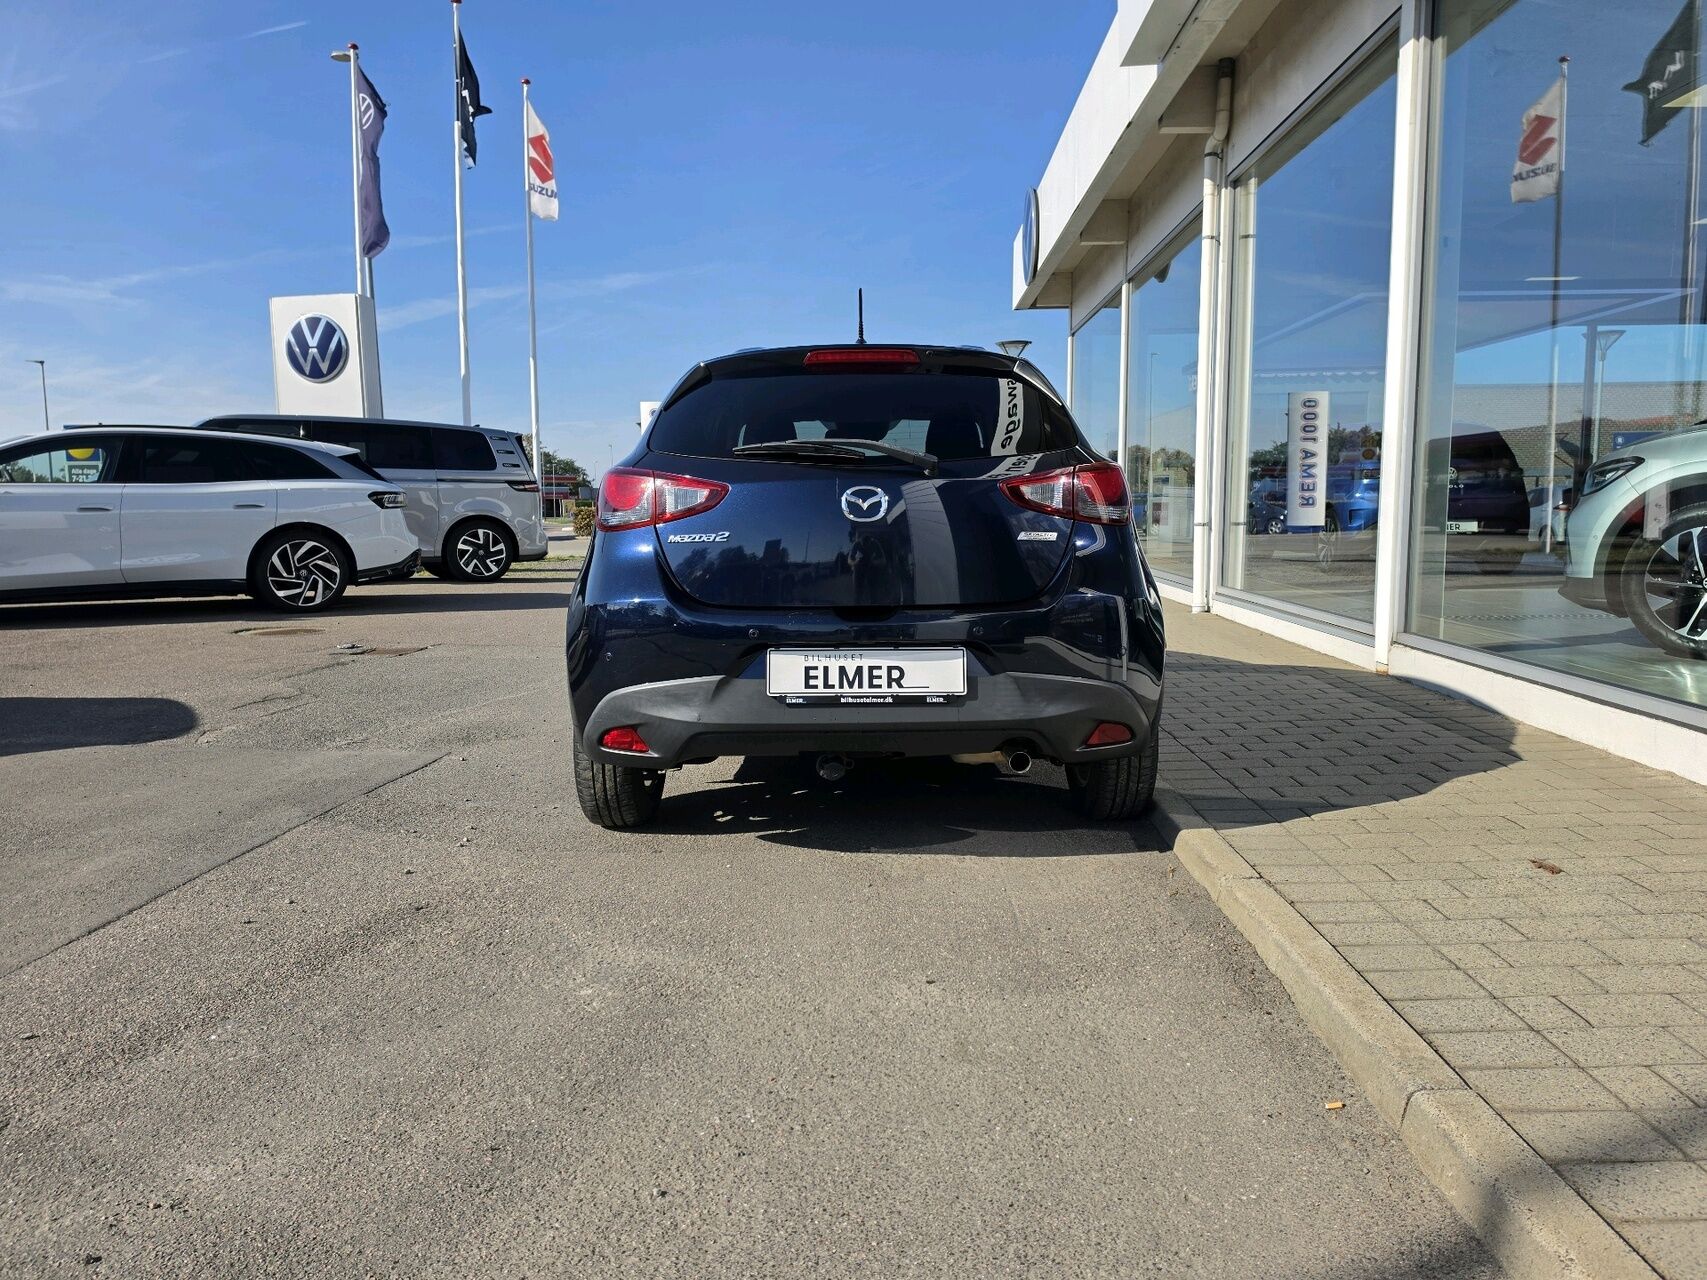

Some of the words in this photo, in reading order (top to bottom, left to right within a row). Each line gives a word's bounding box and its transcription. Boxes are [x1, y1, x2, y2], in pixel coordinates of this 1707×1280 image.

[804, 654, 864, 662] BILHUSET
[804, 665, 906, 689] ELMER
[840, 696, 893, 704] bilhusetelmer.dk
